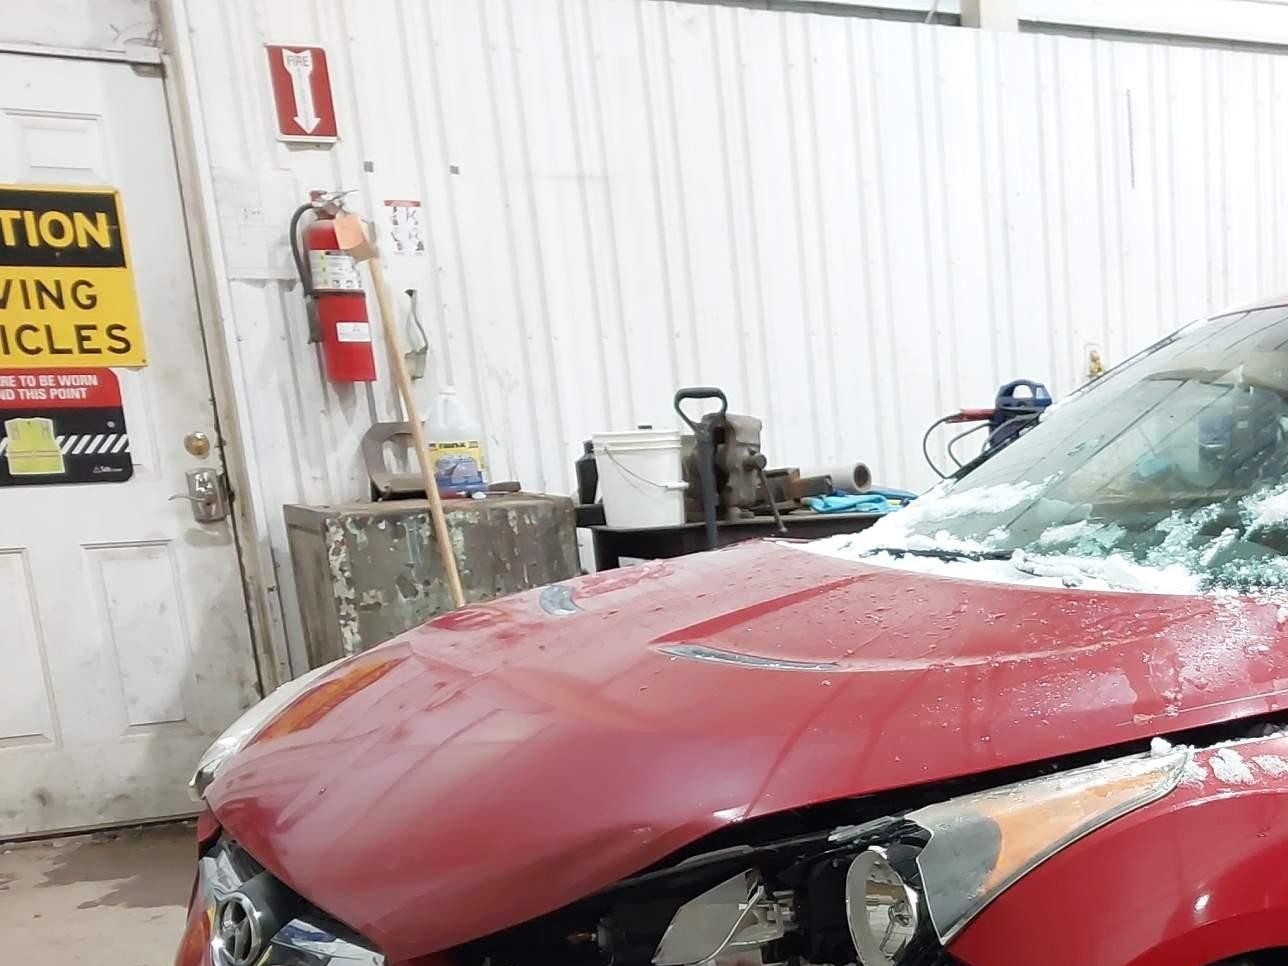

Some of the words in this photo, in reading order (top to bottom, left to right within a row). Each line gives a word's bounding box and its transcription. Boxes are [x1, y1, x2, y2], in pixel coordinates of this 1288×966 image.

[18, 375, 37, 387] TO
[39, 374, 56, 386] BE
[57, 374, 99, 386] WORN
[17, 388, 47, 400] THIS
[49, 387, 88, 400] POINT
